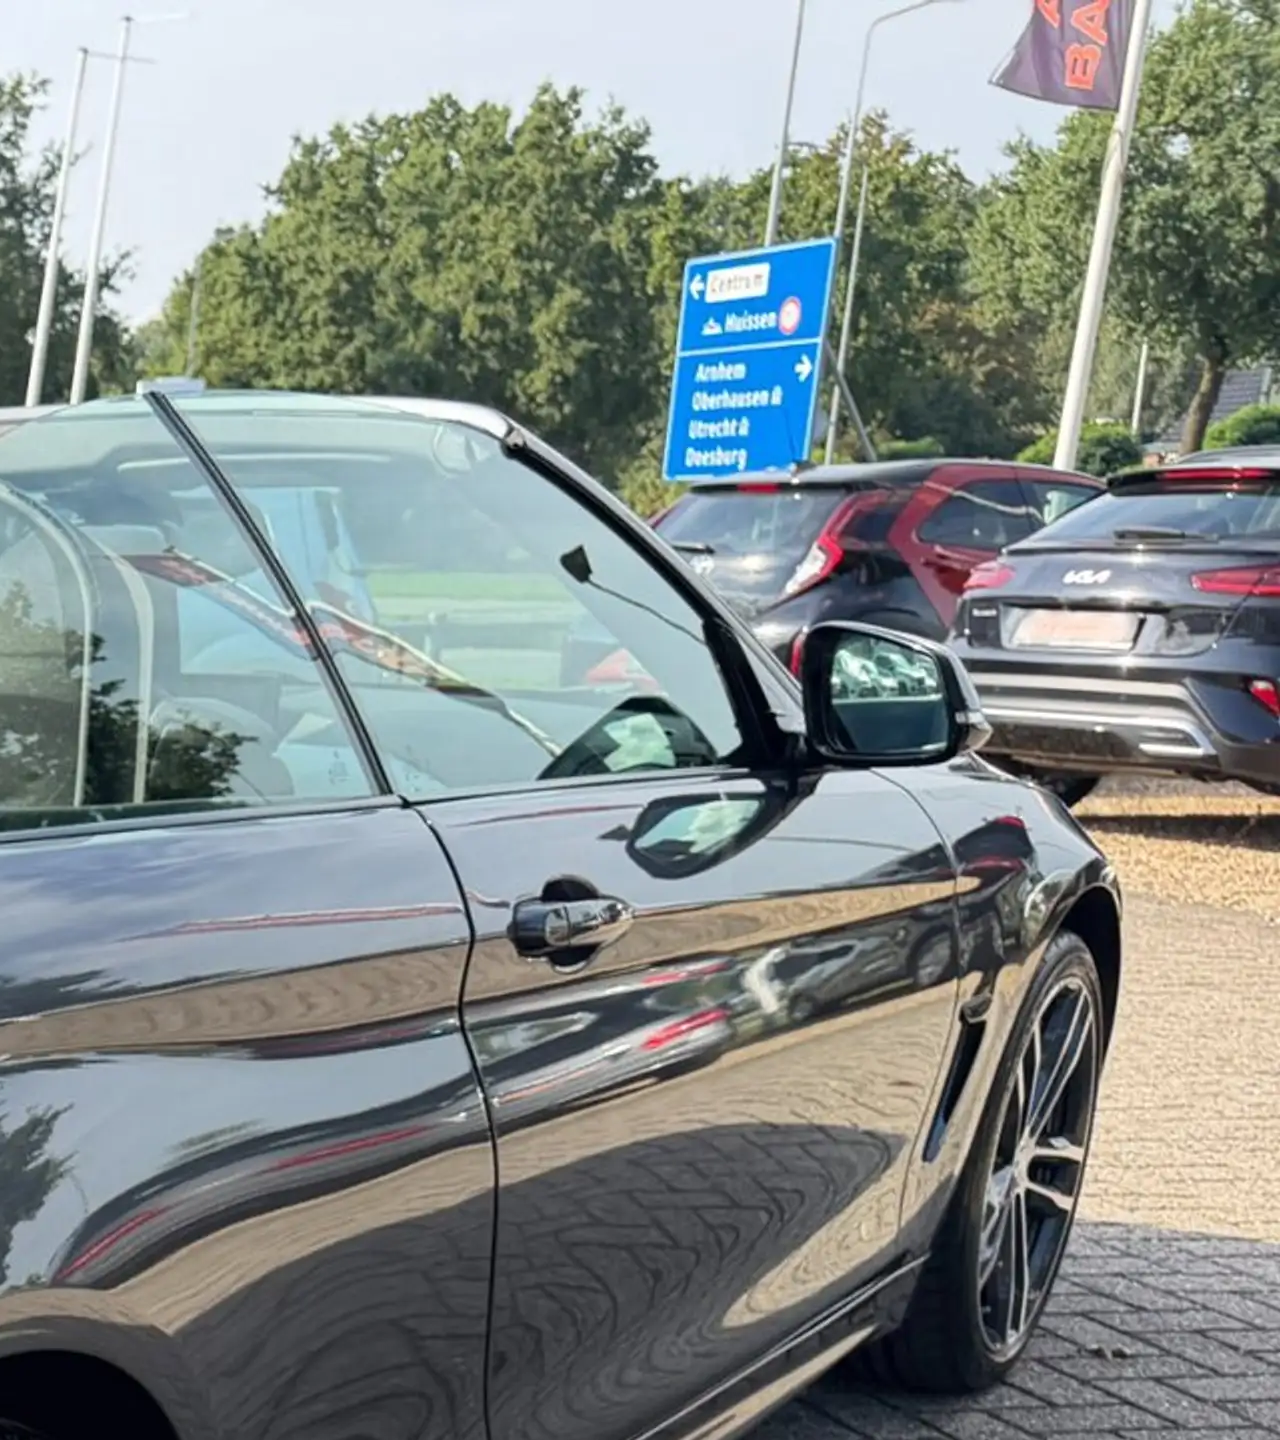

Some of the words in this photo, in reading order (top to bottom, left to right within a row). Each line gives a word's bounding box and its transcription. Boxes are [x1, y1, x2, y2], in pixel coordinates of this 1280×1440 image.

[711, 273, 763, 295] Centrum
[724, 310, 776, 333] Huissen
[694, 361, 747, 383] Arnhem
[692, 388, 768, 410] Oberhausen
[688, 418, 740, 440] Utrecht
[685, 447, 748, 471] Doesburg
